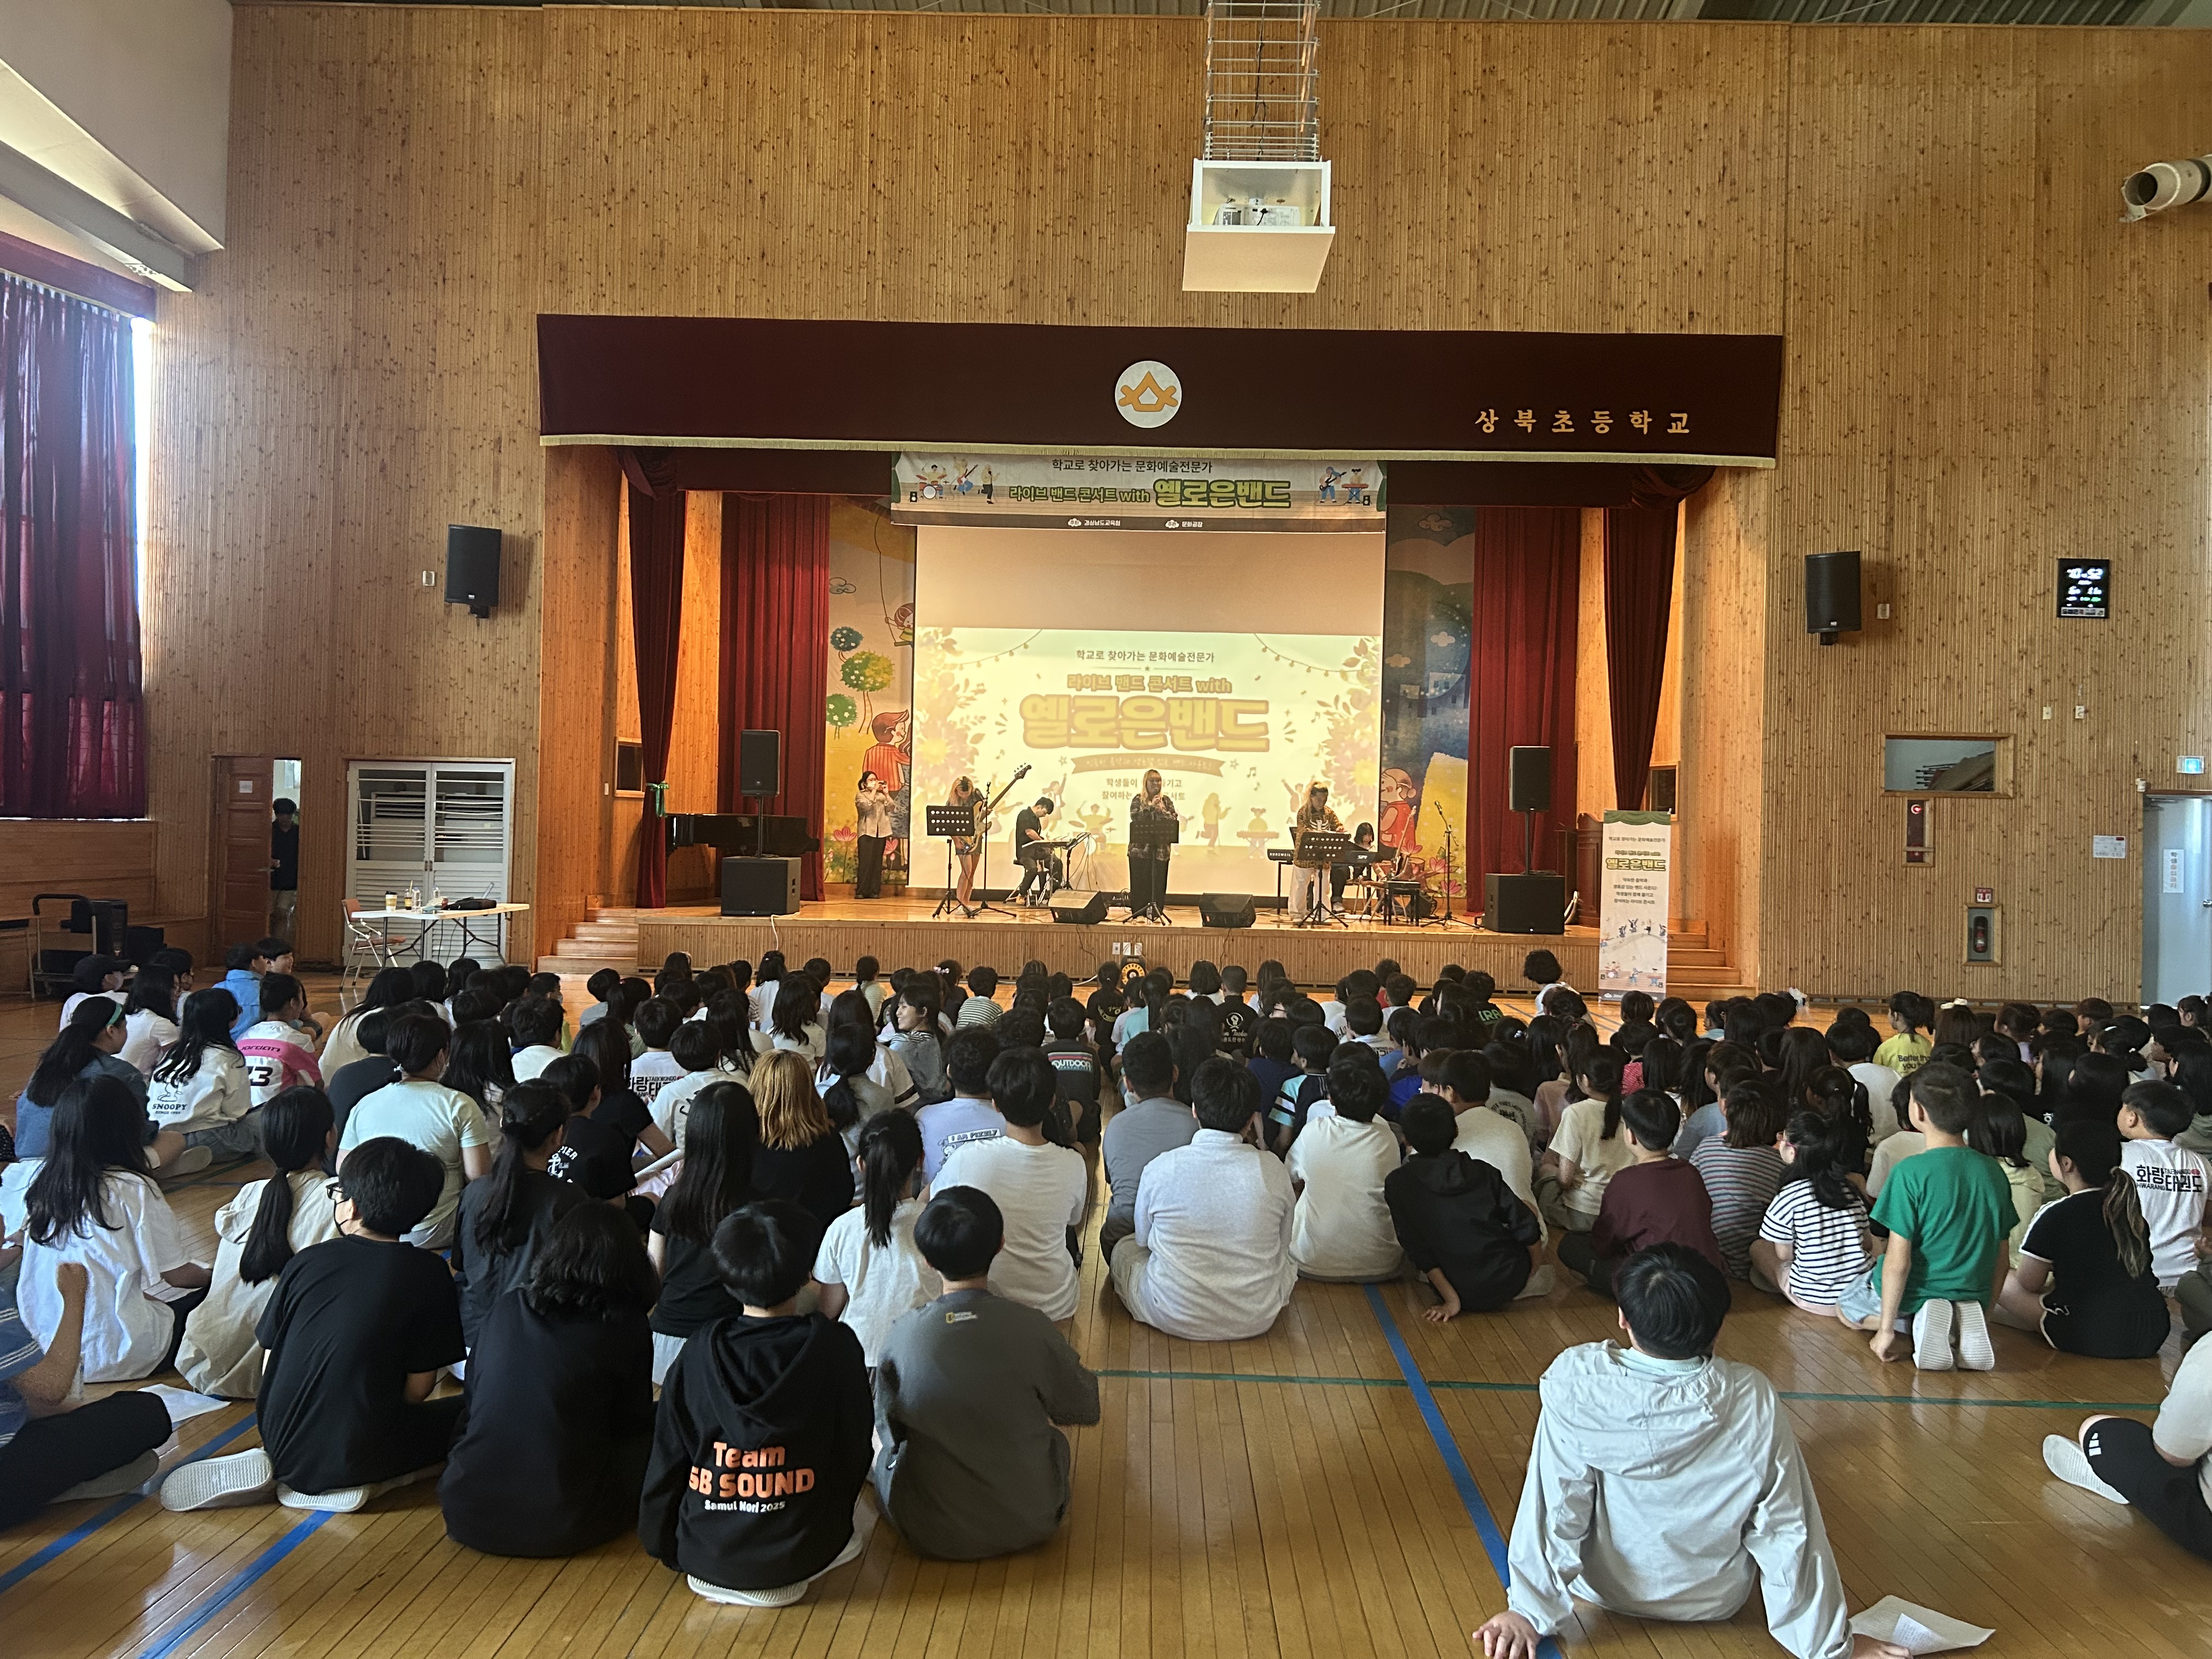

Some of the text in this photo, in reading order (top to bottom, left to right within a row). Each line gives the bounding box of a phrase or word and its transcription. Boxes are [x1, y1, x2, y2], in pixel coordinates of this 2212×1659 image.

[1475, 409, 1690, 434] 상북초등학교
[1052, 459, 1212, 473] 학교로 찾아가는 문화예술전문가
[1009, 478, 1291, 509] 라이브 밴드 콘서트 with 옐로은밴드
[1076, 650, 1214, 663] 학교로 찾아가는 문화예술전문가
[1067, 674, 1232, 693] 라이브 밴드 콘서트 with
[1019, 694, 1269, 752] 옐로은밴드
[1107, 778, 1137, 787] 학생들이
[1102, 791, 1132, 800] 참여하는
[1052, 1059, 1091, 1071] OUTDOOR
[247, 1066, 273, 1086] 3
[714, 1441, 785, 1468] Team
[719, 1468, 815, 1498] SOUND
[760, 1500, 786, 1513] 2025
